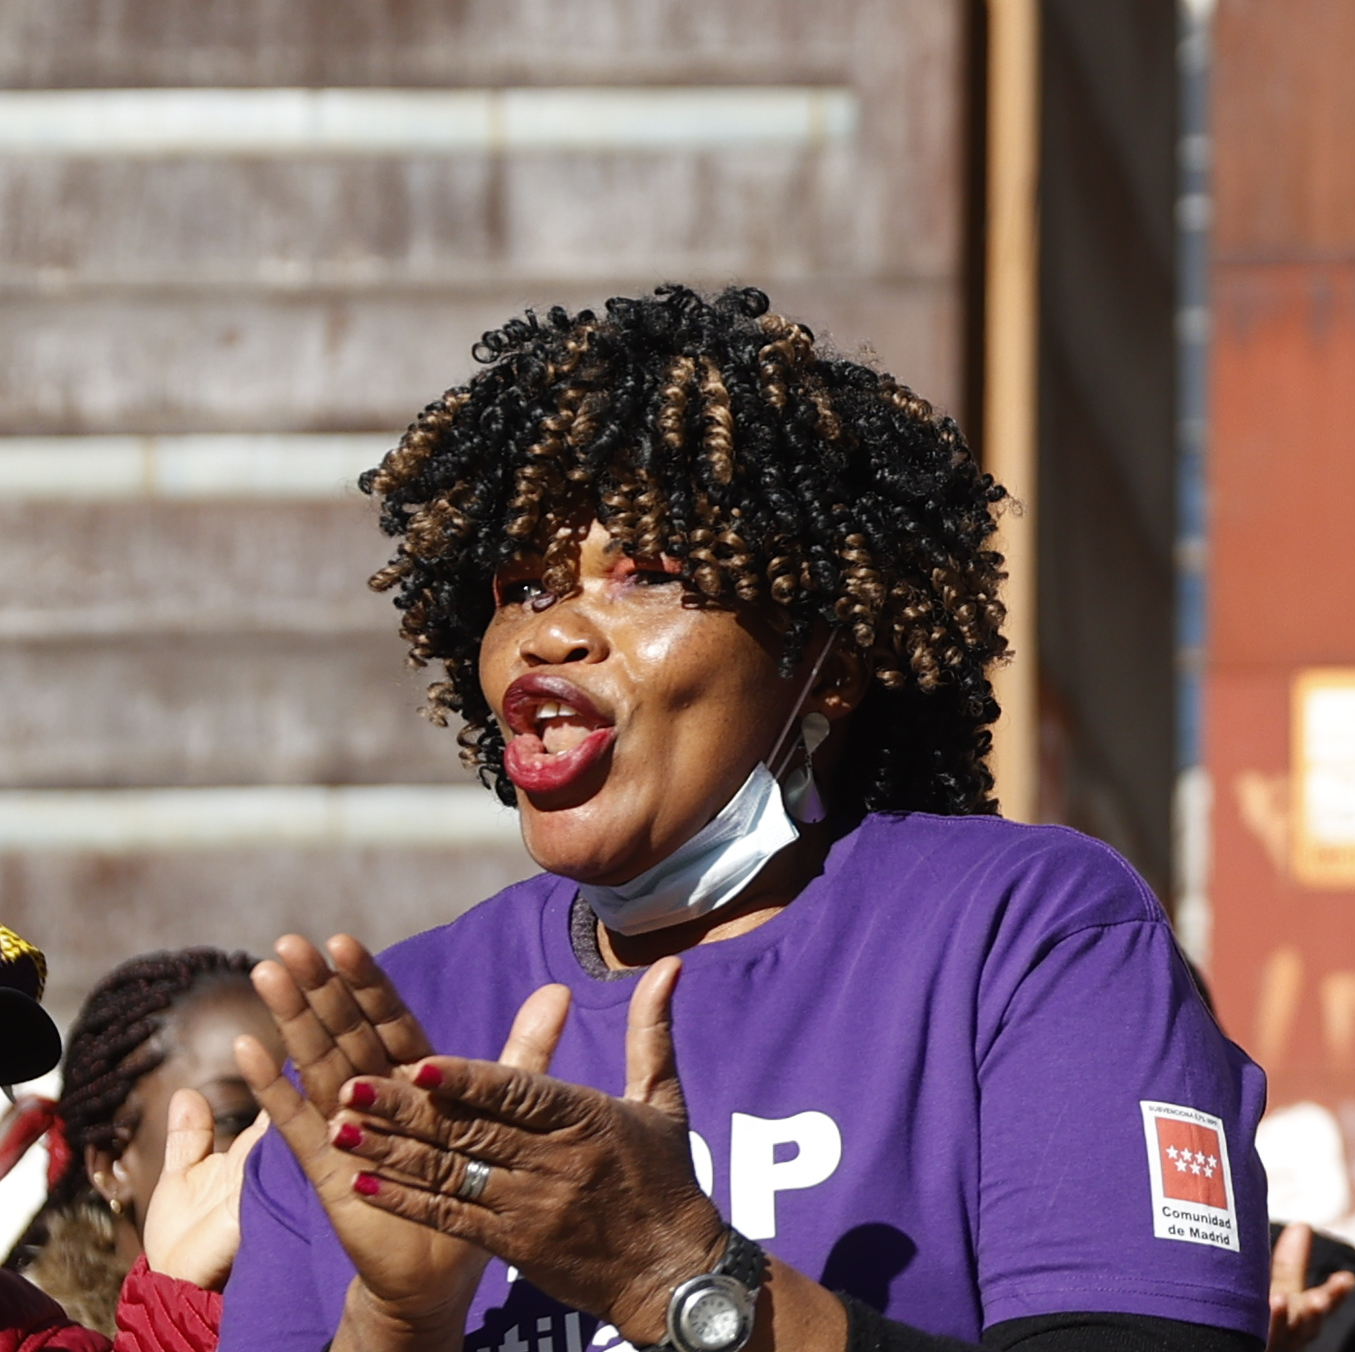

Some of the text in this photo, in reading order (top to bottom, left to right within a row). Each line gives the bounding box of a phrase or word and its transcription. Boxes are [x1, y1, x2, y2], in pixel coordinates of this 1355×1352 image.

[1162, 1206, 1231, 1229] Comunidad
[1168, 1225, 1230, 1245] de Madrid
